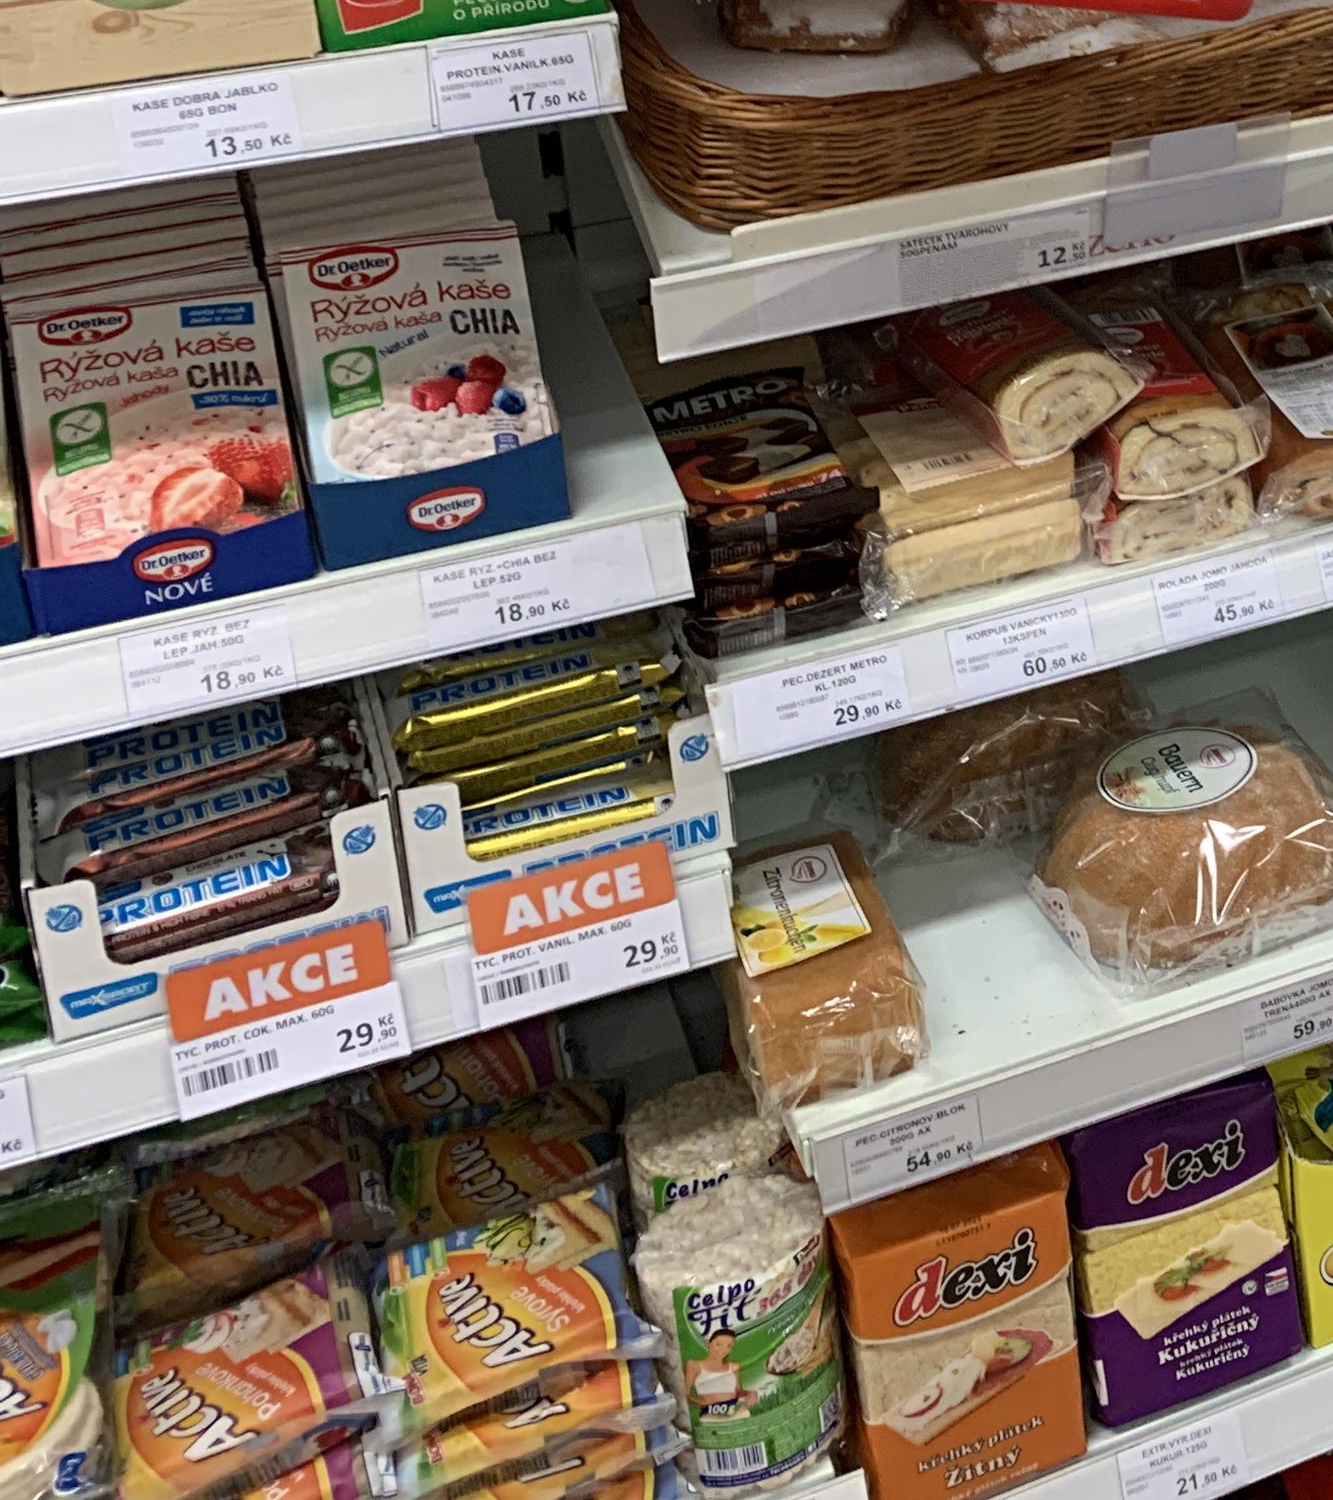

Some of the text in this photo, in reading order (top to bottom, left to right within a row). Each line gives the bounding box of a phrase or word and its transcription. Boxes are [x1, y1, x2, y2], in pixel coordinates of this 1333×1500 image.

[454, 8, 466, 20] O
[492, 48, 525, 60] KASE
[132, 82, 278, 112] KASE DOBRA JABLKO
[1037, 246, 1068, 268] 12
[312, 279, 511, 322] Rýžová kaše
[316, 310, 442, 341] Ryžová kaša
[450, 309, 520, 335] CHIA
[41, 333, 255, 382] Rýžová kaše
[377, 329, 429, 357] Natural
[127, 364, 179, 386] kaša
[187, 362, 264, 388] CHIA
[654, 379, 787, 423] METRO
[433, 552, 557, 584] KASE BEZ
[143, 575, 213, 606] NOVÉ
[153, 620, 250, 647] KASE BEZ
[846, 655, 887, 672] METRO
[413, 653, 589, 711] PROTEIN
[89, 777, 289, 851] PROTEIN
[98, 854, 290, 929] PROTEIN
[503, 867, 644, 935] AKCE
[624, 940, 657, 968] 29
[205, 945, 357, 1019] AKCE
[336, 1026, 372, 1053] 29
[1127, 1121, 1245, 1205] dexi
[892, 1229, 1037, 1326] dexi
[689, 1280, 755, 1310] Celpo
[438, 1269, 554, 1369] Active
[139, 1372, 258, 1462] Active
[945, 1446, 1021, 1489] Žitný
